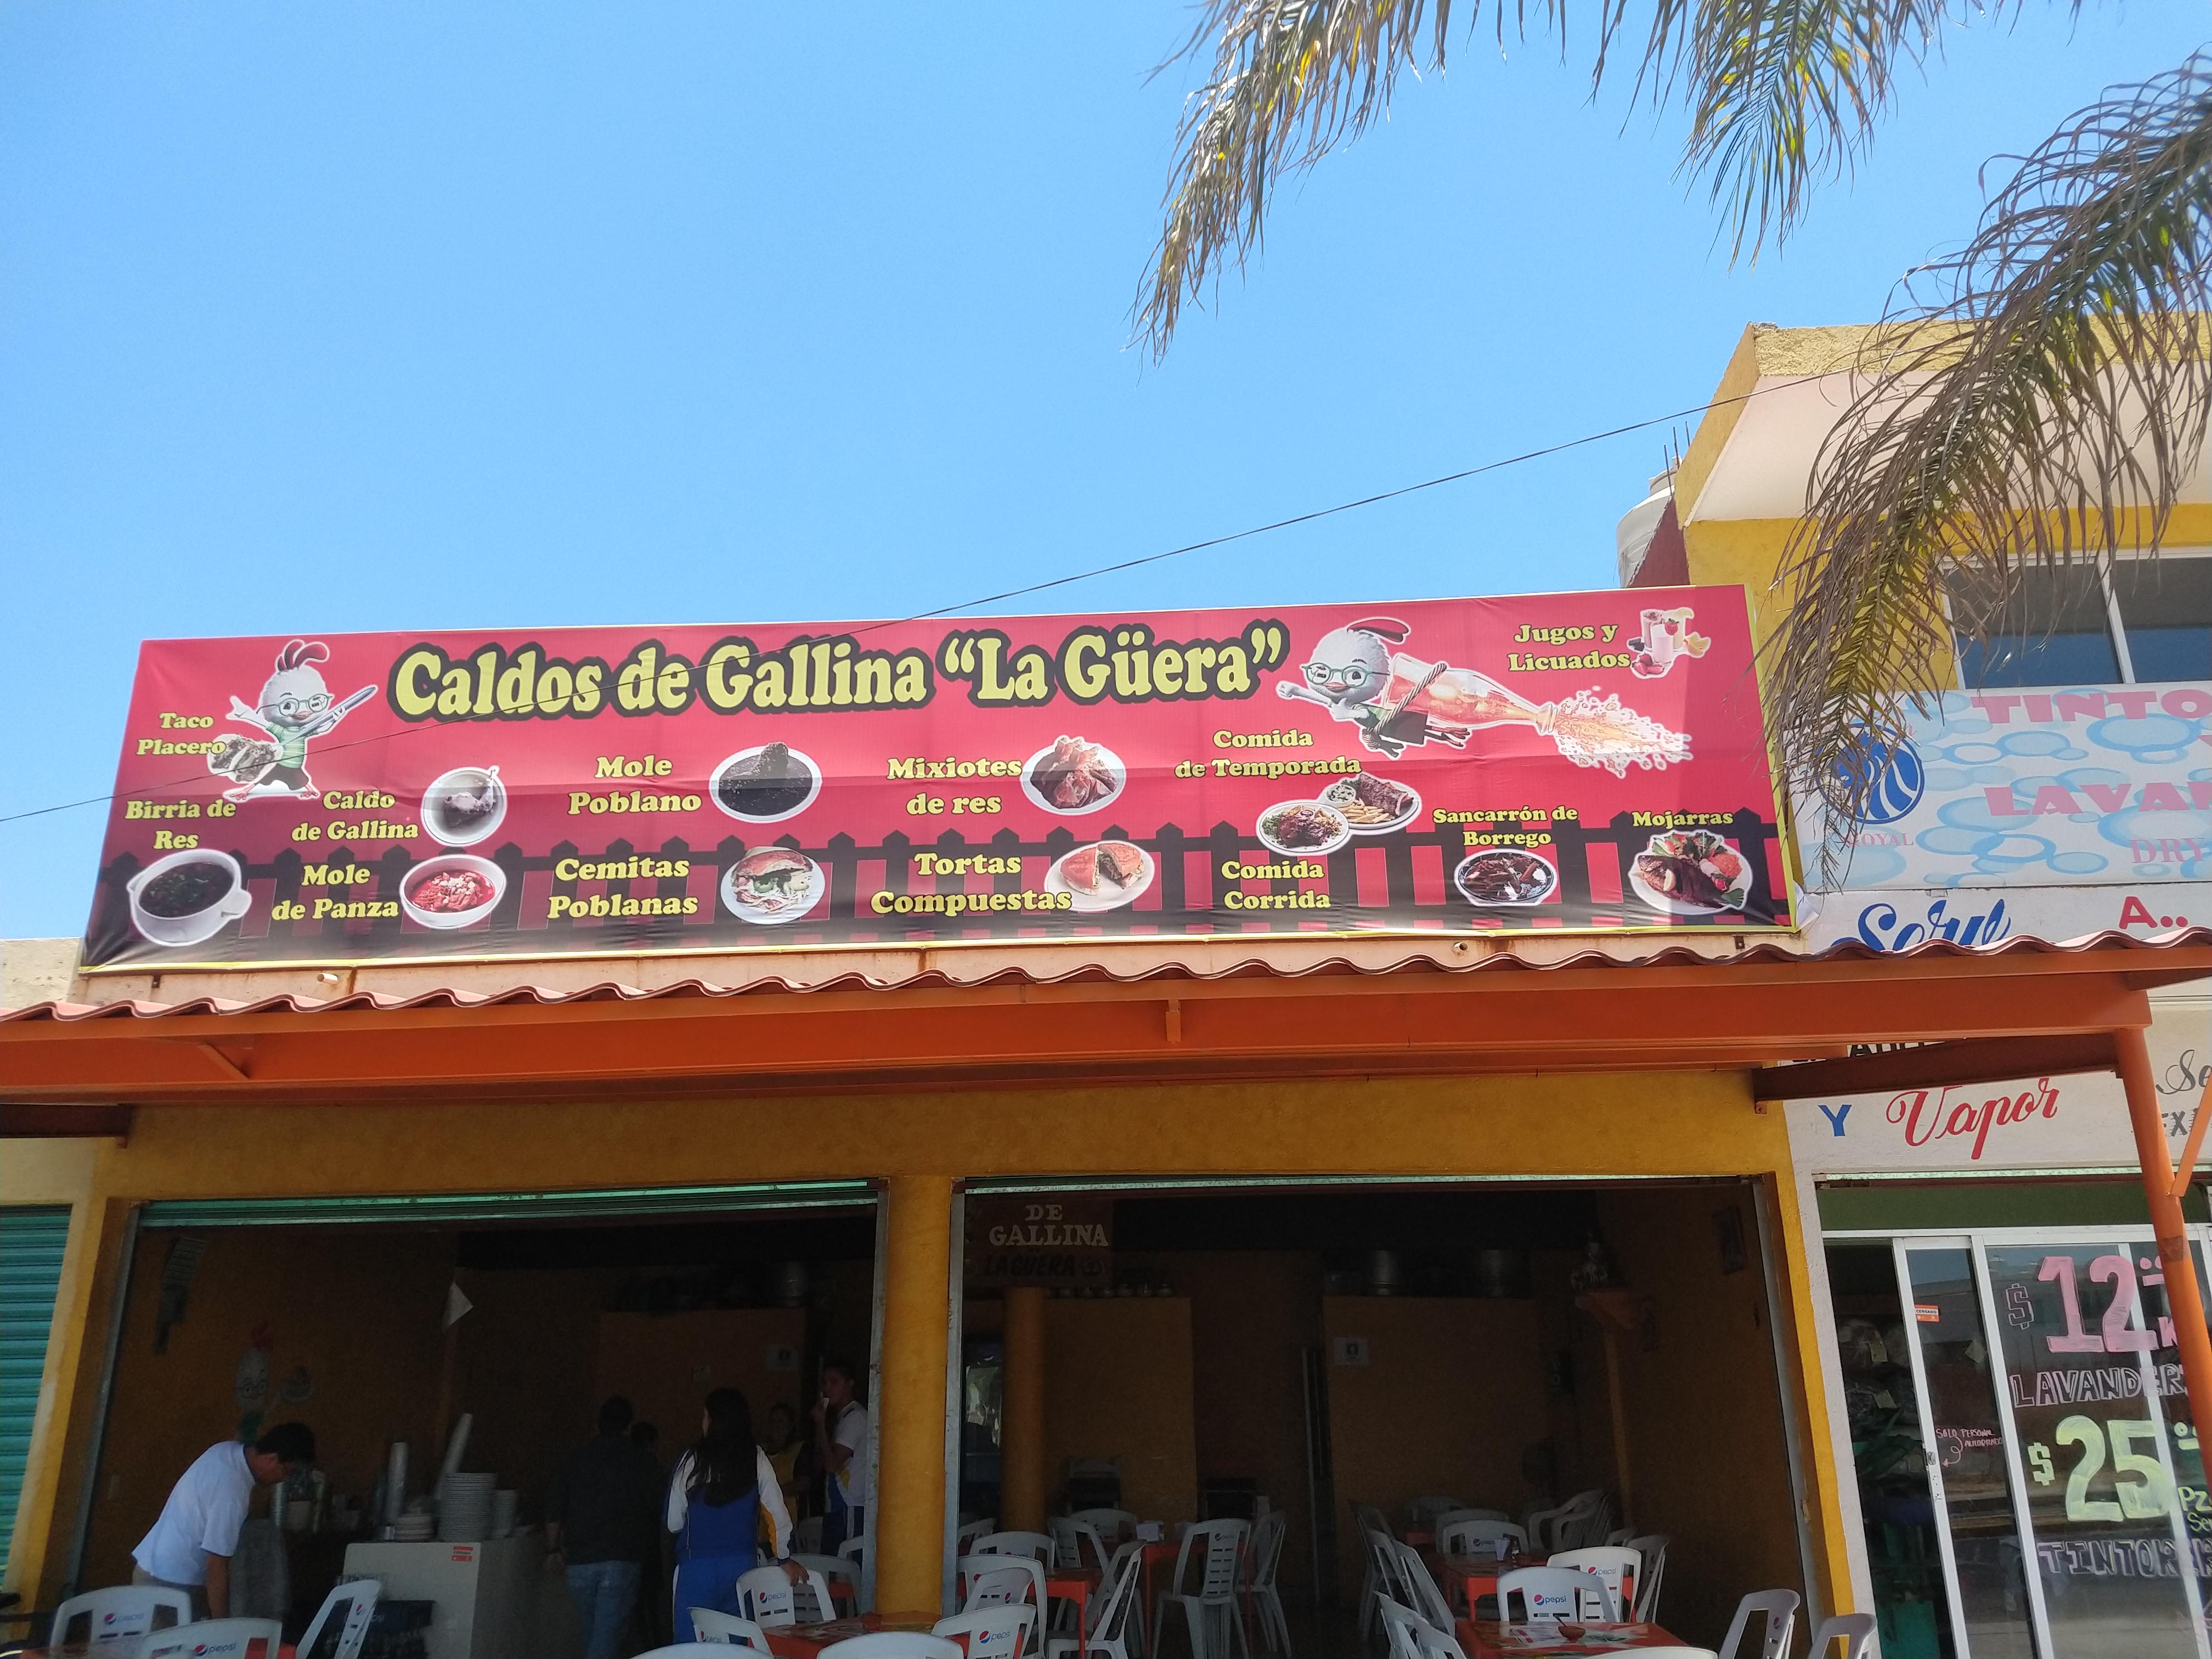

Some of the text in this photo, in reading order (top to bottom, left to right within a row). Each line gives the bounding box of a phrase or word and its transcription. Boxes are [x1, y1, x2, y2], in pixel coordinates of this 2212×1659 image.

[1516, 623, 1619, 645] Jugos y
[1509, 651, 1630, 672] Licuados
[396, 650, 602, 716] Caldos
[617, 647, 689, 710] de
[706, 643, 926, 709] Gallina
[159, 712, 214, 729] Taco
[136, 738, 225, 756] Placero
[1214, 730, 1312, 748] Comida
[597, 754, 672, 778] Mole
[887, 758, 1022, 779] Mixiotes
[1175, 757, 1362, 780] de Temporada
[125, 799, 236, 820] Birria de
[323, 790, 395, 810] Caldo
[569, 791, 702, 815] Poblano
[906, 793, 1002, 815] de res
[1433, 805, 1578, 825] Sancarrón de
[1631, 810, 1734, 831] Mojarras
[154, 830, 198, 850] Res
[291, 820, 419, 842] de Gallina
[1463, 830, 1553, 849] Borrego
[2130, 838, 2206, 864] DRY
[301, 862, 372, 886] Mole
[554, 855, 691, 882] Cemitas
[913, 851, 1022, 876] Tortas
[1220, 859, 1324, 881] Comida
[270, 897, 400, 922] de Panza
[548, 893, 698, 920] Poblanas
[871, 890, 1072, 918] Compuestas
[1223, 889, 1331, 911] Corrida
[1818, 1077, 2060, 1160] Y Vapor
[1024, 1204, 1063, 1222] DE
[989, 1223, 1109, 1247] GALLINA
[2009, 1363, 2190, 1408] LAVANDER
[1598, 1567, 1617, 1576] pepsi
[768, 1592, 787, 1601] pepsi
[1544, 1594, 1567, 1605] pepsi
[991, 1630, 1011, 1642] pepsi
[207, 1642, 238, 1655] pepsi
